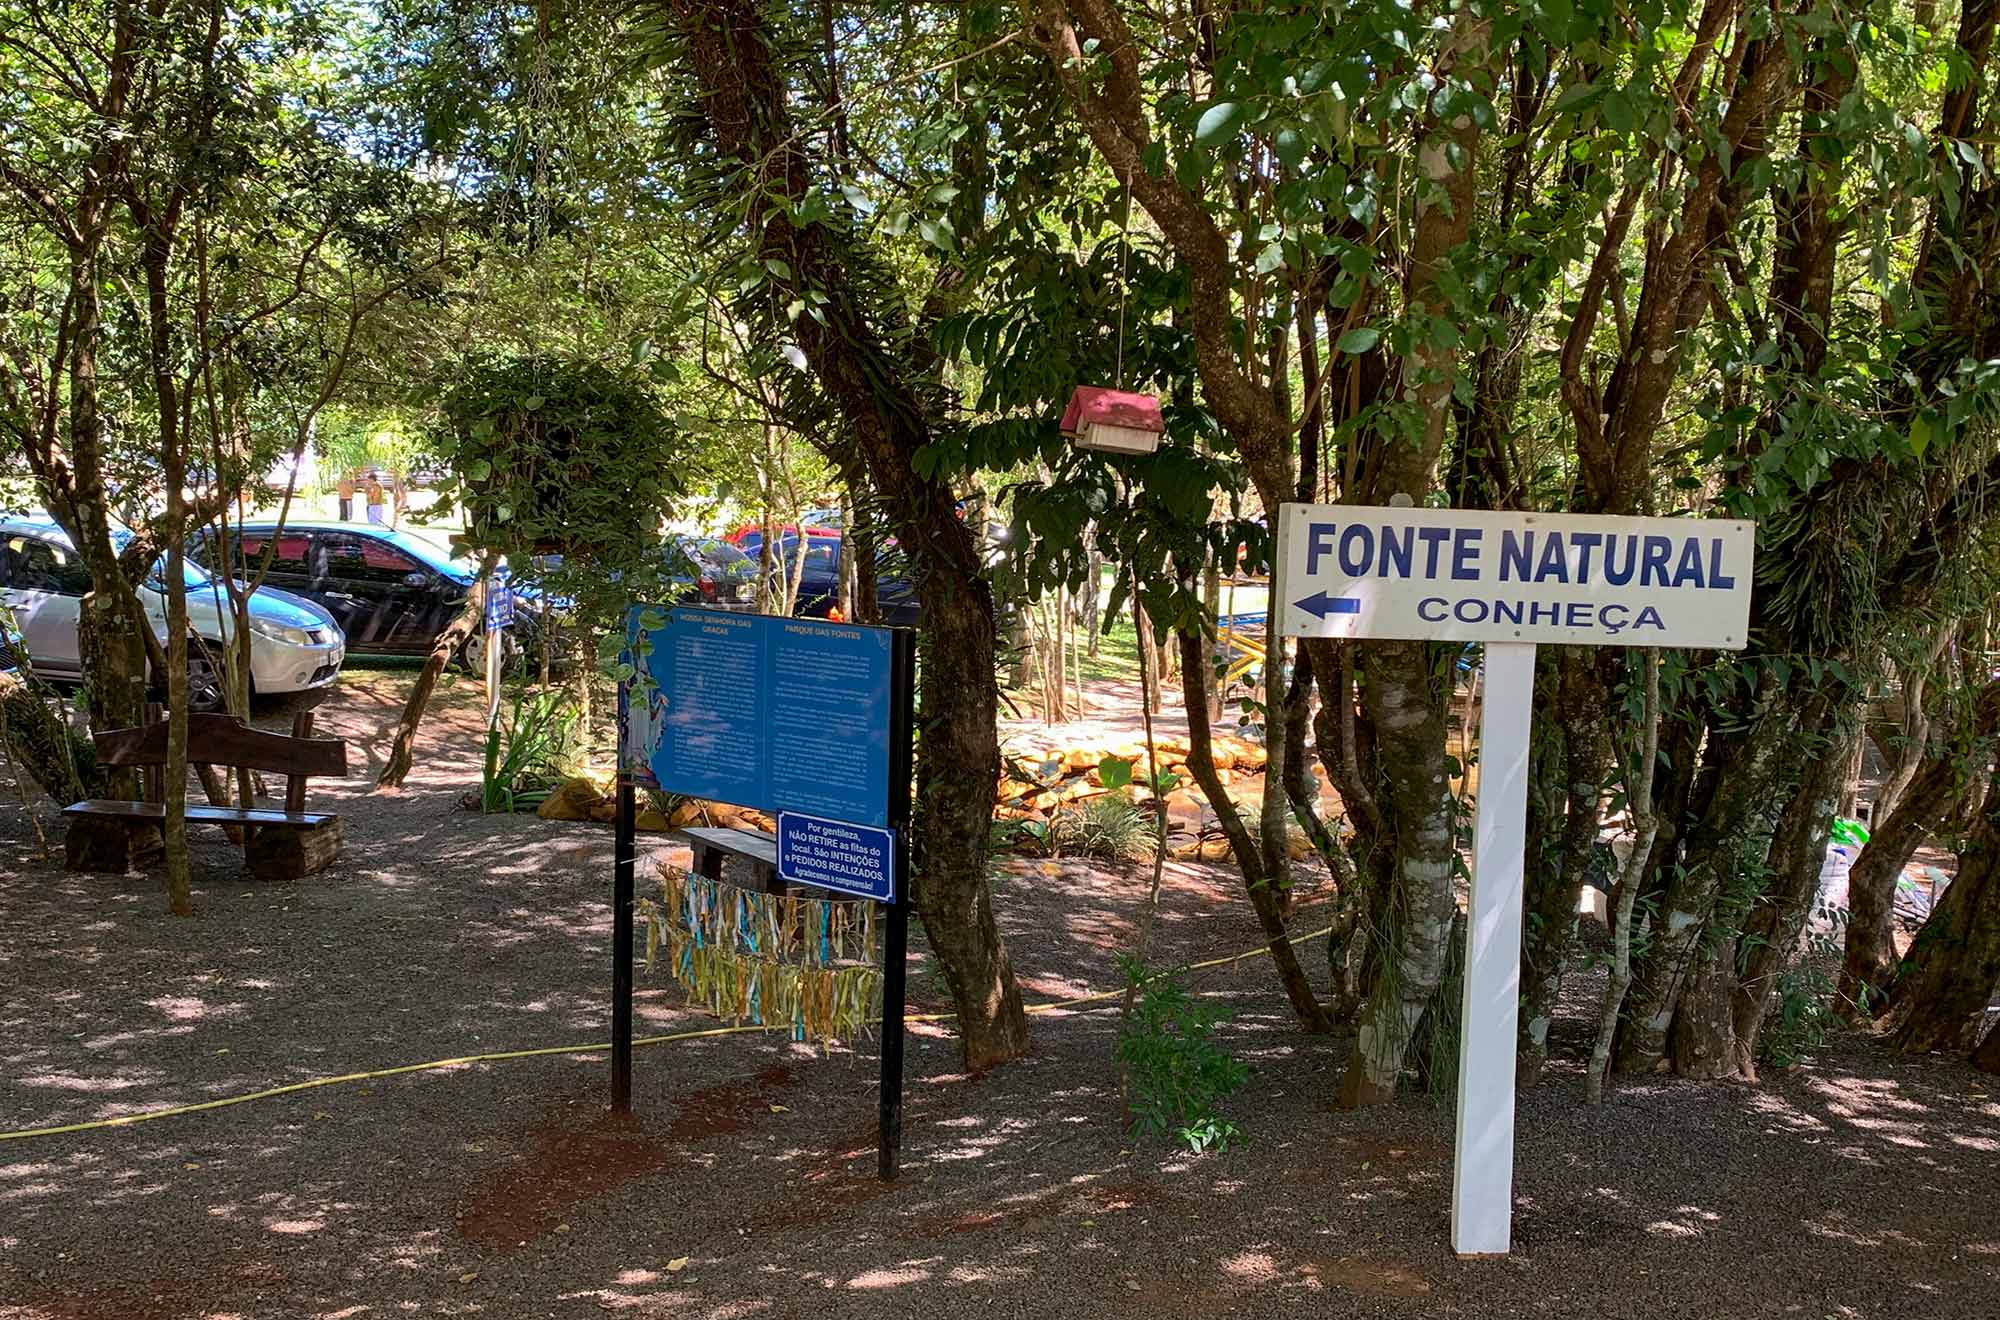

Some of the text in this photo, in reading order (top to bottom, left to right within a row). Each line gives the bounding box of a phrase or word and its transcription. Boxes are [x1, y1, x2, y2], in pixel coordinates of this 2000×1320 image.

[1305, 522, 1736, 590] FONTE NATURAL
[737, 619, 752, 628] DAS
[1416, 596, 1666, 635] CONHEÇA
[784, 624, 861, 640] PARQUE DAS FONTES
[788, 829, 881, 857] NÃO RETIRE as fitas do
[807, 822, 861, 841] Por gentileza,
[791, 842, 880, 869] local. São INTENÇÕES
[791, 854, 827, 870] PEDIDOS
[828, 861, 886, 881] REALIZADOS.
[794, 866, 830, 882] Agradecemos
